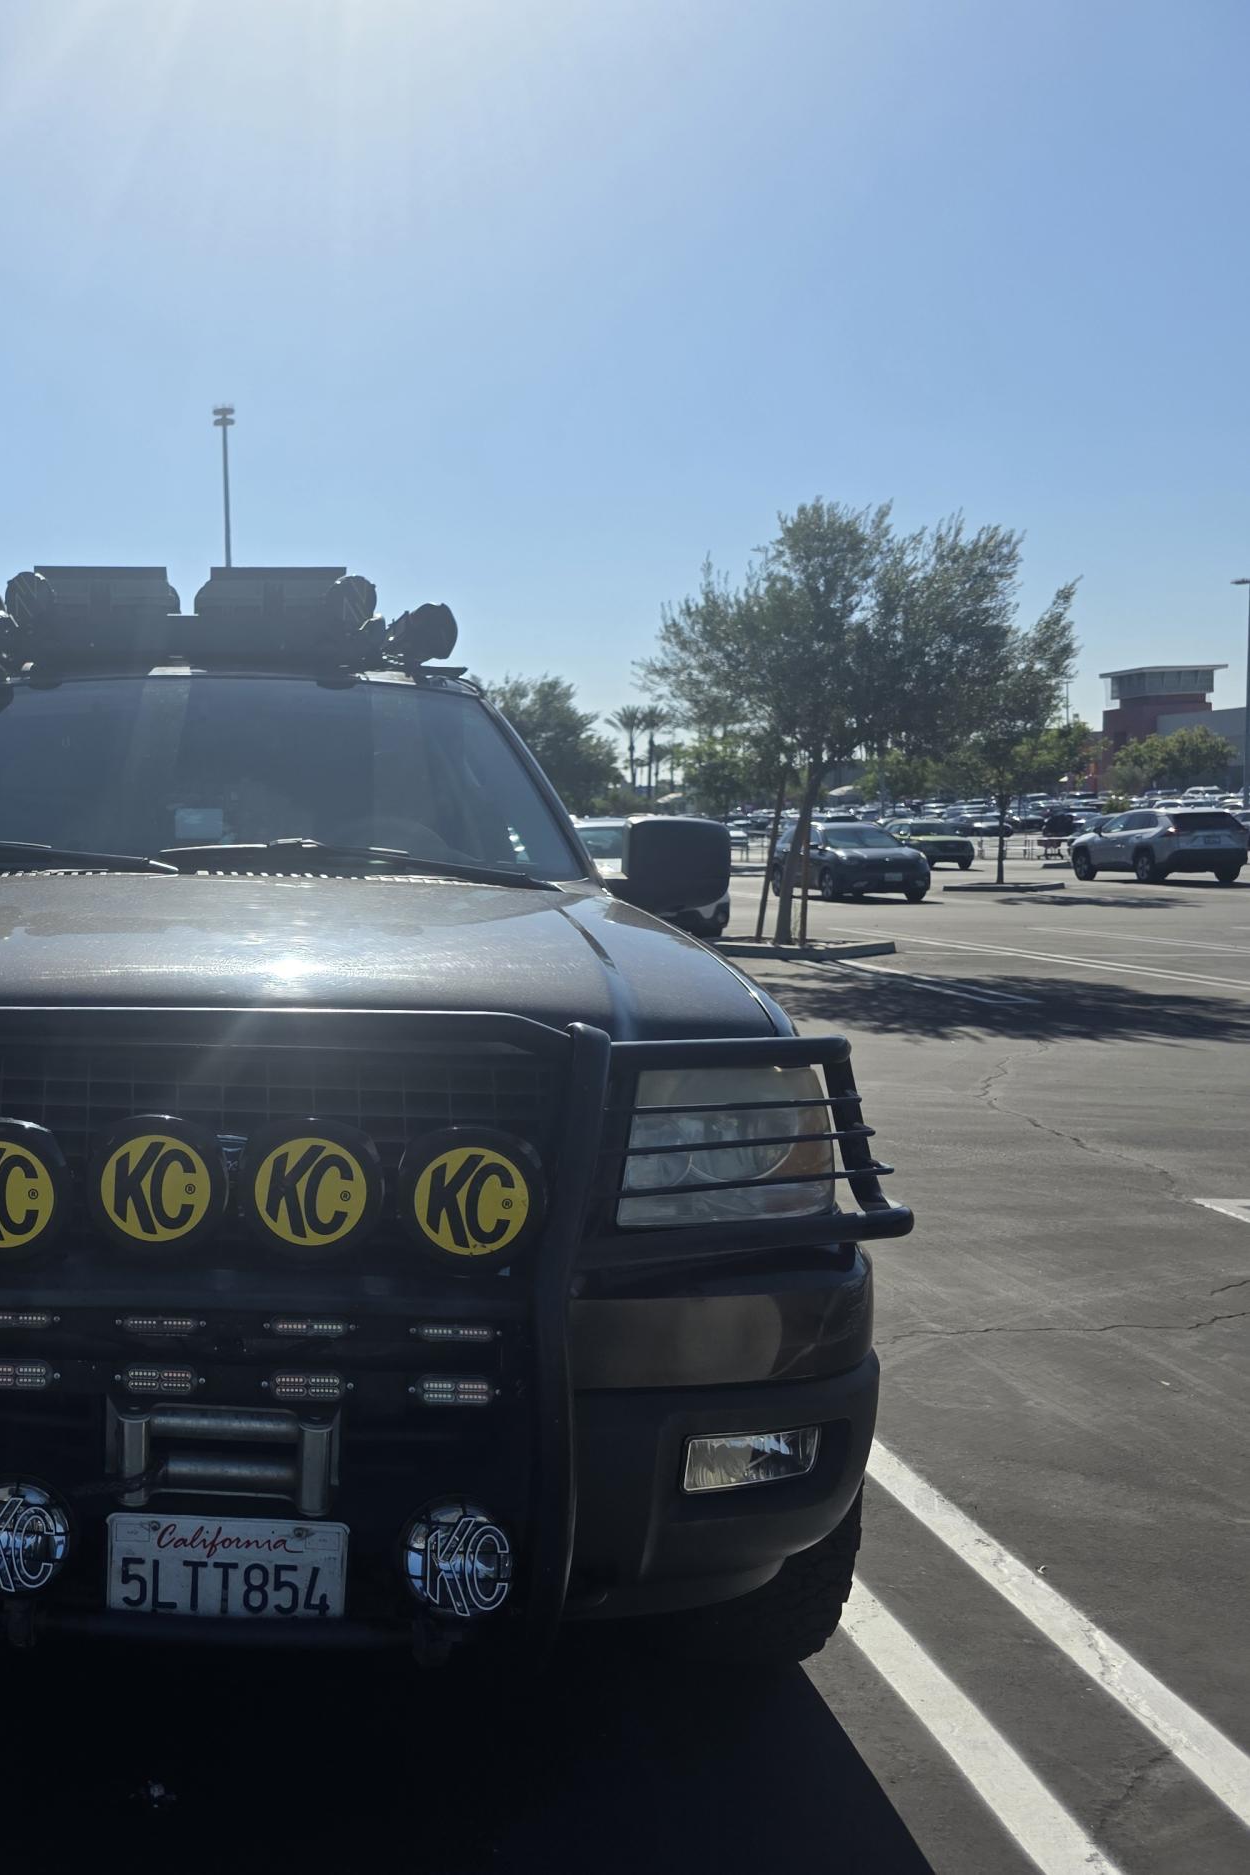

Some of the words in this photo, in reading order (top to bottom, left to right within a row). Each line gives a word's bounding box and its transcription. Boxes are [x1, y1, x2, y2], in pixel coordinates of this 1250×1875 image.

[157, 1523, 304, 1558] California
[426, 1517, 510, 1617] KC
[121, 1557, 330, 1617] 5LTT854
